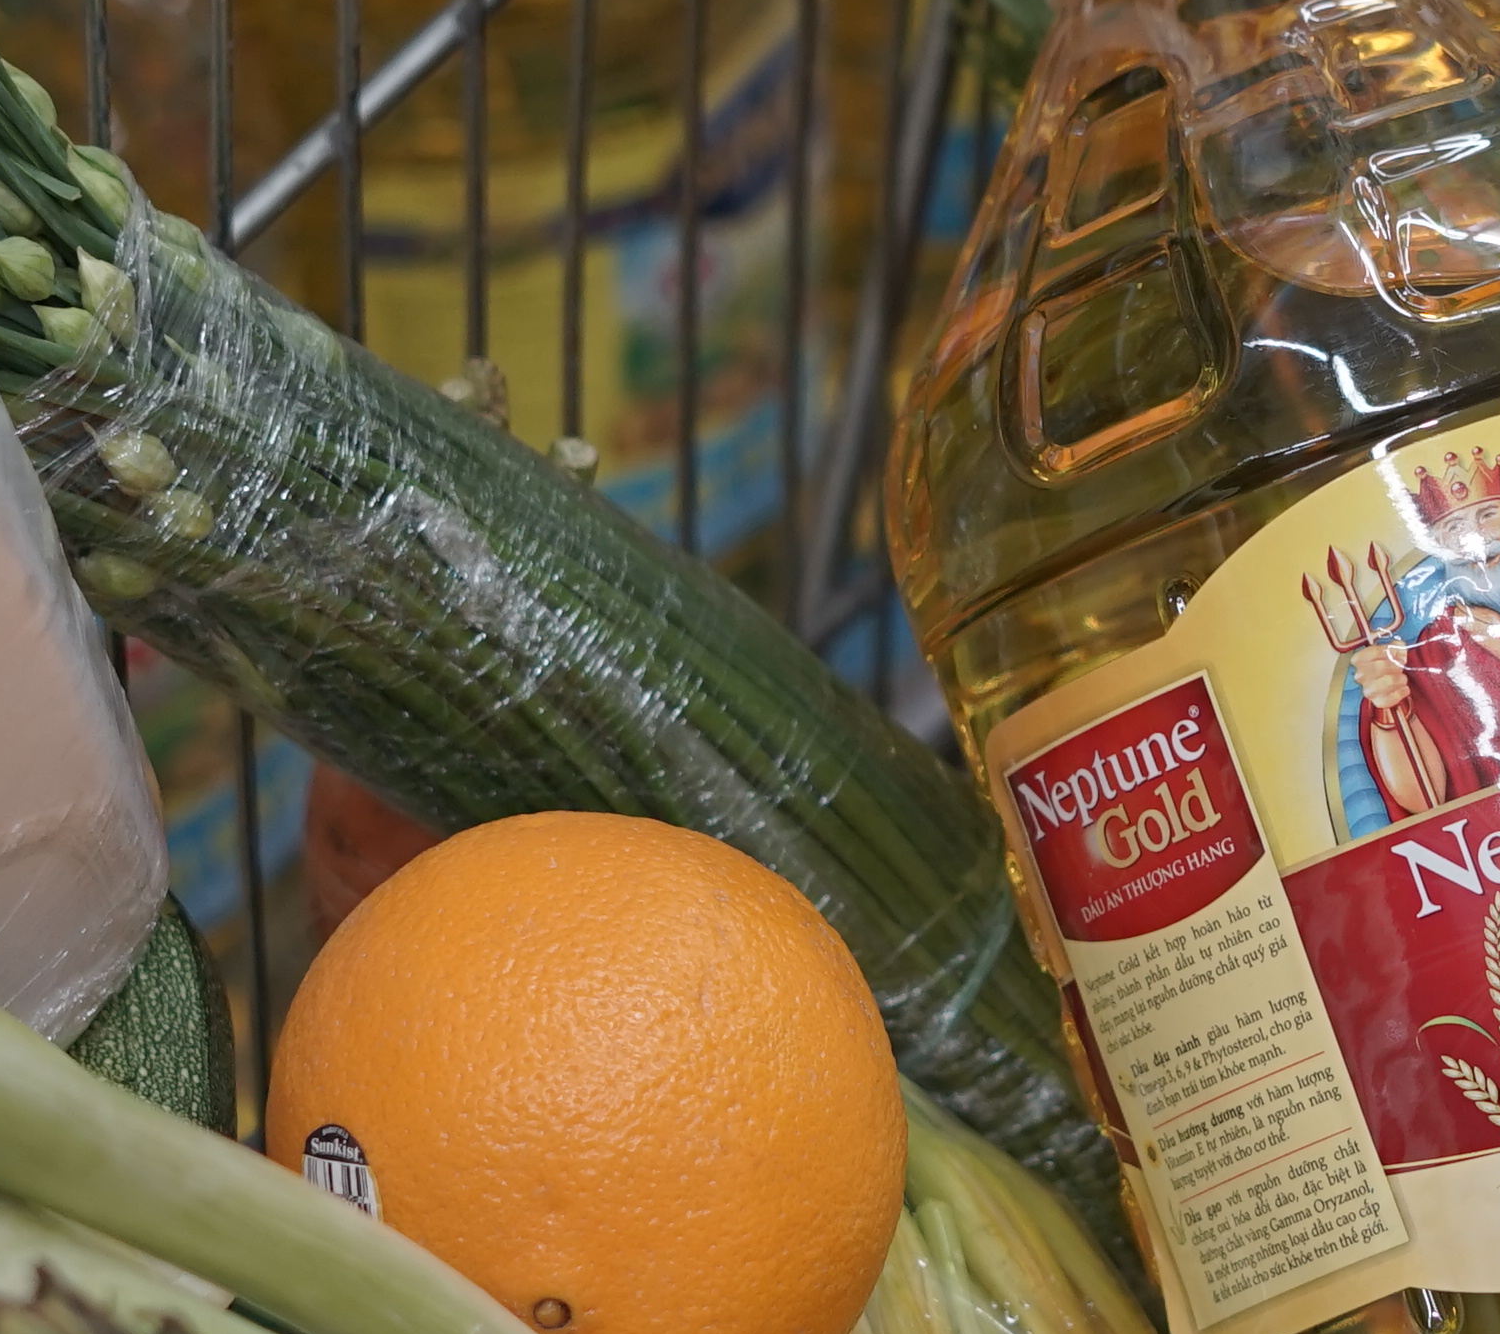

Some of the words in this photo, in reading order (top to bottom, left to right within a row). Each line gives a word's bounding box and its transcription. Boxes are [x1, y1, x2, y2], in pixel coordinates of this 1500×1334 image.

[1096, 767, 1222, 869] Gold
[1122, 859, 1185, 900] THƯỢNG
[1185, 837, 1235, 871] HẠNG
[1118, 953, 1141, 975] Gold
[1143, 943, 1161, 963] kết
[1163, 935, 1186, 952] hợp
[1190, 920, 1222, 940] hoàn
[1226, 906, 1251, 924] hảo
[1257, 895, 1273, 910] từ
[1179, 970, 1215, 993] dưỡng
[1215, 954, 1240, 976] chất
[1242, 944, 1264, 967] quý
[1268, 934, 1288, 958] giá
[1199, 946, 1213, 960] tự
[1217, 930, 1253, 952] nhiên
[1258, 918, 1280, 934] cao
[1175, 1035, 1201, 1057] nành
[1207, 1024, 1230, 1046] giàu
[1235, 1010, 1263, 1029] hàm
[1268, 991, 1307, 1014] lượng
[1175, 1065, 1186, 1079] 6,
[1201, 1027, 1268, 1067] Phytosterol,
[1270, 1020, 1292, 1036] cho
[1294, 1010, 1313, 1030] gia
[1181, 1080, 1199, 1098] trái
[1199, 1075, 1218, 1090] tim
[1217, 1061, 1246, 1082] khỏe
[1248, 1044, 1286, 1068] mạnh.
[1210, 1105, 1245, 1127] dương
[1246, 1092, 1265, 1110] với
[1266, 1084, 1294, 1102] hàm
[1295, 1067, 1334, 1089] lượng
[1219, 1125, 1252, 1147] nhiên,
[1252, 1116, 1265, 1131] là
[1267, 1098, 1306, 1125] nguồn
[1308, 1086, 1342, 1107] năng
[1234, 1146, 1252, 1161] cho
[1254, 1138, 1266, 1152] cơ
[1267, 1125, 1290, 1146] thể.
[1225, 1189, 1243, 1207] với
[1246, 1173, 1282, 1200] nguồn
[1288, 1157, 1328, 1180] dưỡng
[1334, 1138, 1361, 1161] chất
[1275, 1192, 1299, 1208] dào,
[1303, 1180, 1324, 1196] đặc
[1325, 1167, 1351, 1186] biệt
[1354, 1160, 1367, 1175] là
[1255, 1240, 1290, 1262] những
[1287, 1227, 1310, 1247] loại
[1311, 1218, 1334, 1237] dầu
[1336, 1212, 1356, 1227] cao
[1359, 1198, 1380, 1218] cấp
[1269, 1208, 1313, 1232] Gamma
[1313, 1179, 1374, 1213] Oryzanol,
[1252, 1270, 1270, 1285] cho
[1269, 1262, 1287, 1278] sức
[1285, 1250, 1314, 1270] khỏe
[1313, 1241, 1339, 1259] trên
[1339, 1226, 1359, 1248] thế
[1361, 1219, 1388, 1244] giới.
